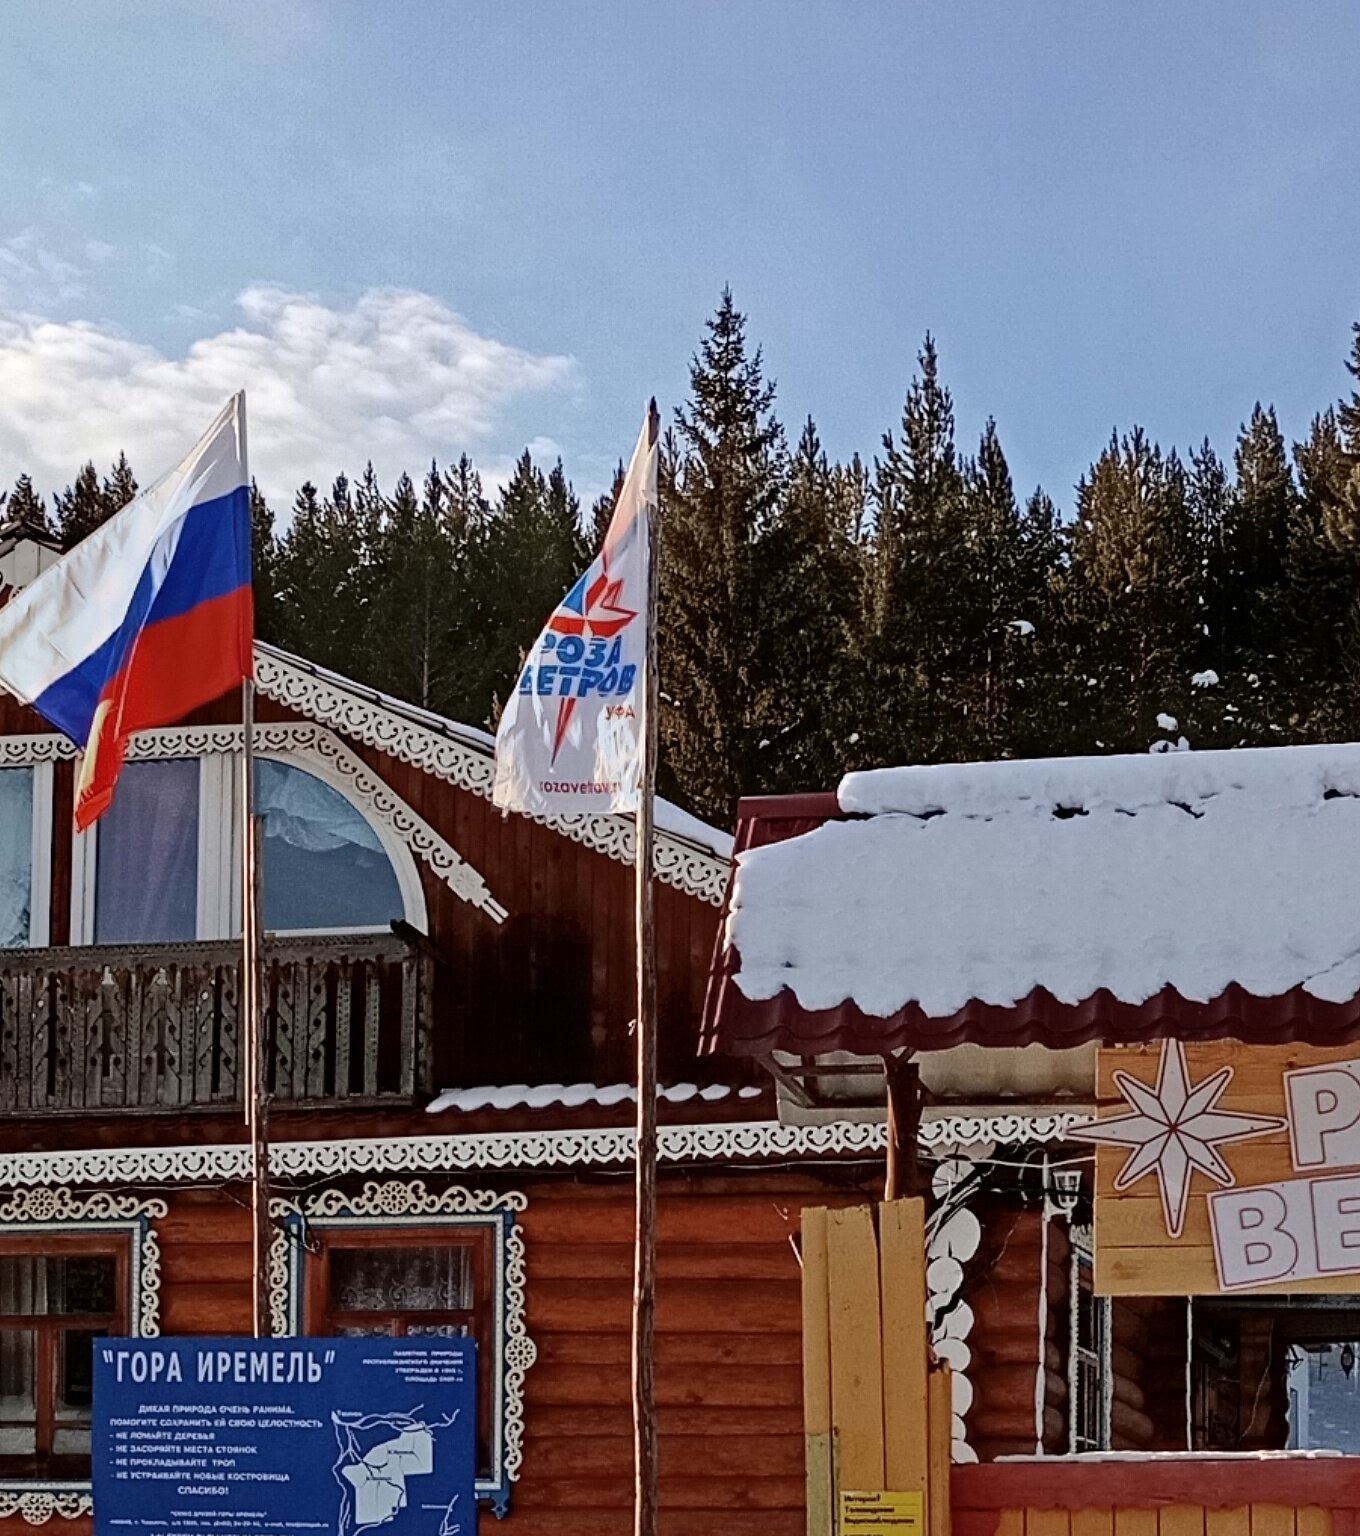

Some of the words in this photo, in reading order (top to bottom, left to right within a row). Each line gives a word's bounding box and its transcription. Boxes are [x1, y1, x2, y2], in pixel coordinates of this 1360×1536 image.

[605, 704, 635, 720] УФА
[138, 1404, 171, 1415] ДИКАЯ
[172, 1404, 218, 1415] ПРИРОДА
[219, 1404, 251, 1415] ОЧЕНЬ
[252, 1404, 295, 1415] РАНИМА.
[109, 1418, 158, 1428] ПОМОГИТЕ
[159, 1418, 212, 1428] СОХРАНИТЬ
[228, 1418, 256, 1428] СВОЮ
[257, 1418, 323, 1428] ЦЕЛОСТНОСТЬ
[115, 1431, 128, 1440] НЕ
[130, 1431, 172, 1440] ЛОМАЙТЕ
[173, 1431, 215, 1440] ДЕРЕВЬЯ
[115, 1444, 128, 1453] НЕ
[129, 1444, 181, 1453] ЗАСОРЯЙТЕ
[183, 1444, 214, 1453] МЕСТА
[215, 1444, 257, 1453] СТОЯНОК
[115, 1458, 128, 1467] НЕ
[129, 1458, 207, 1467] ПРОКЛАДЫВАЙТЕ
[212, 1458, 236, 1467] ТРОП
[116, 1471, 128, 1481] НЕ
[130, 1471, 191, 1481] УСТРАИВАЙТЕ
[193, 1471, 225, 1481] НОВЫЕ
[227, 1471, 290, 1481] КОСТРОВИЩА
[177, 1485, 229, 1495] СПАСИБО!
